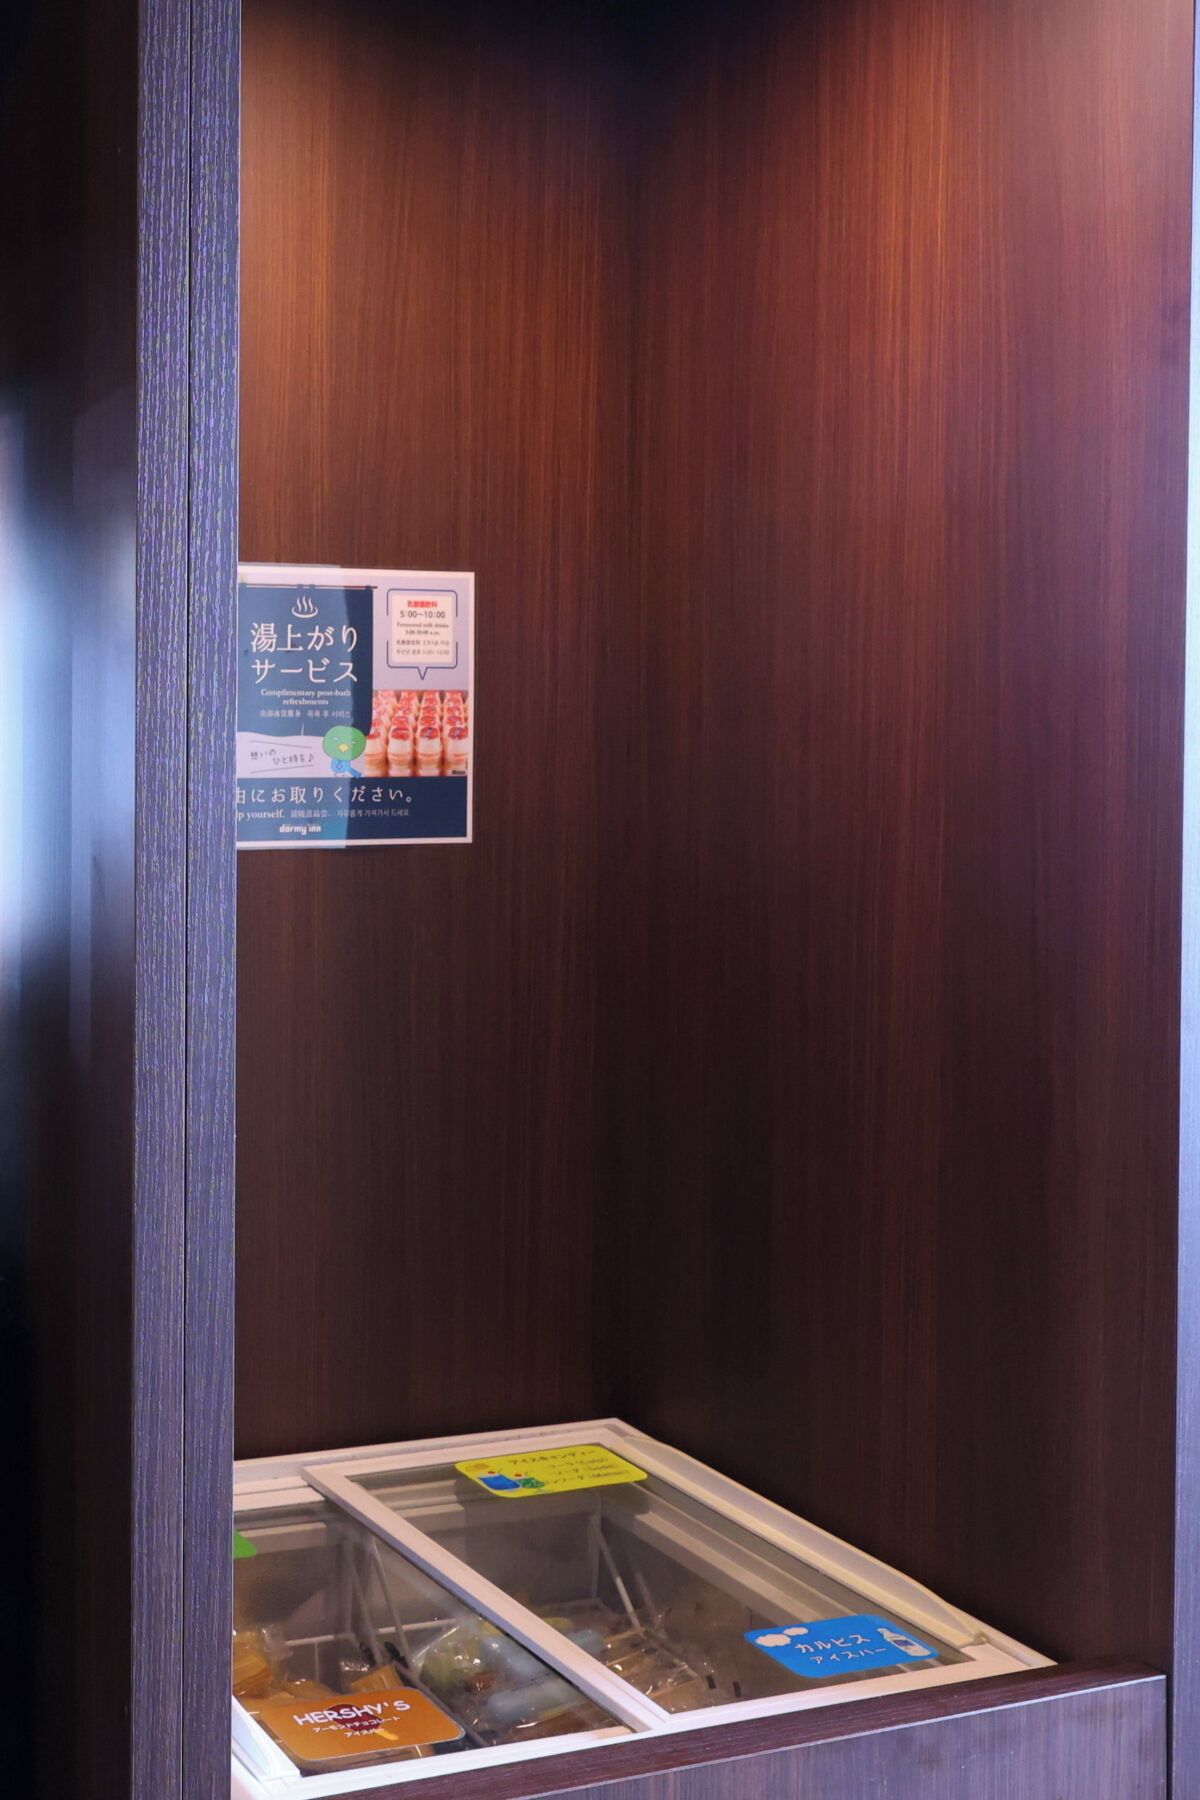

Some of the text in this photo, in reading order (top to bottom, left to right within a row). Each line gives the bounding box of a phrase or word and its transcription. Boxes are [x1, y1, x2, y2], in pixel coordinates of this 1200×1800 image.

[251, 622, 358, 653] 湯上がり
[251, 658, 358, 684] サービス
[246, 809, 286, 822] yourself.
[280, 823, 322, 835] dormy inn
